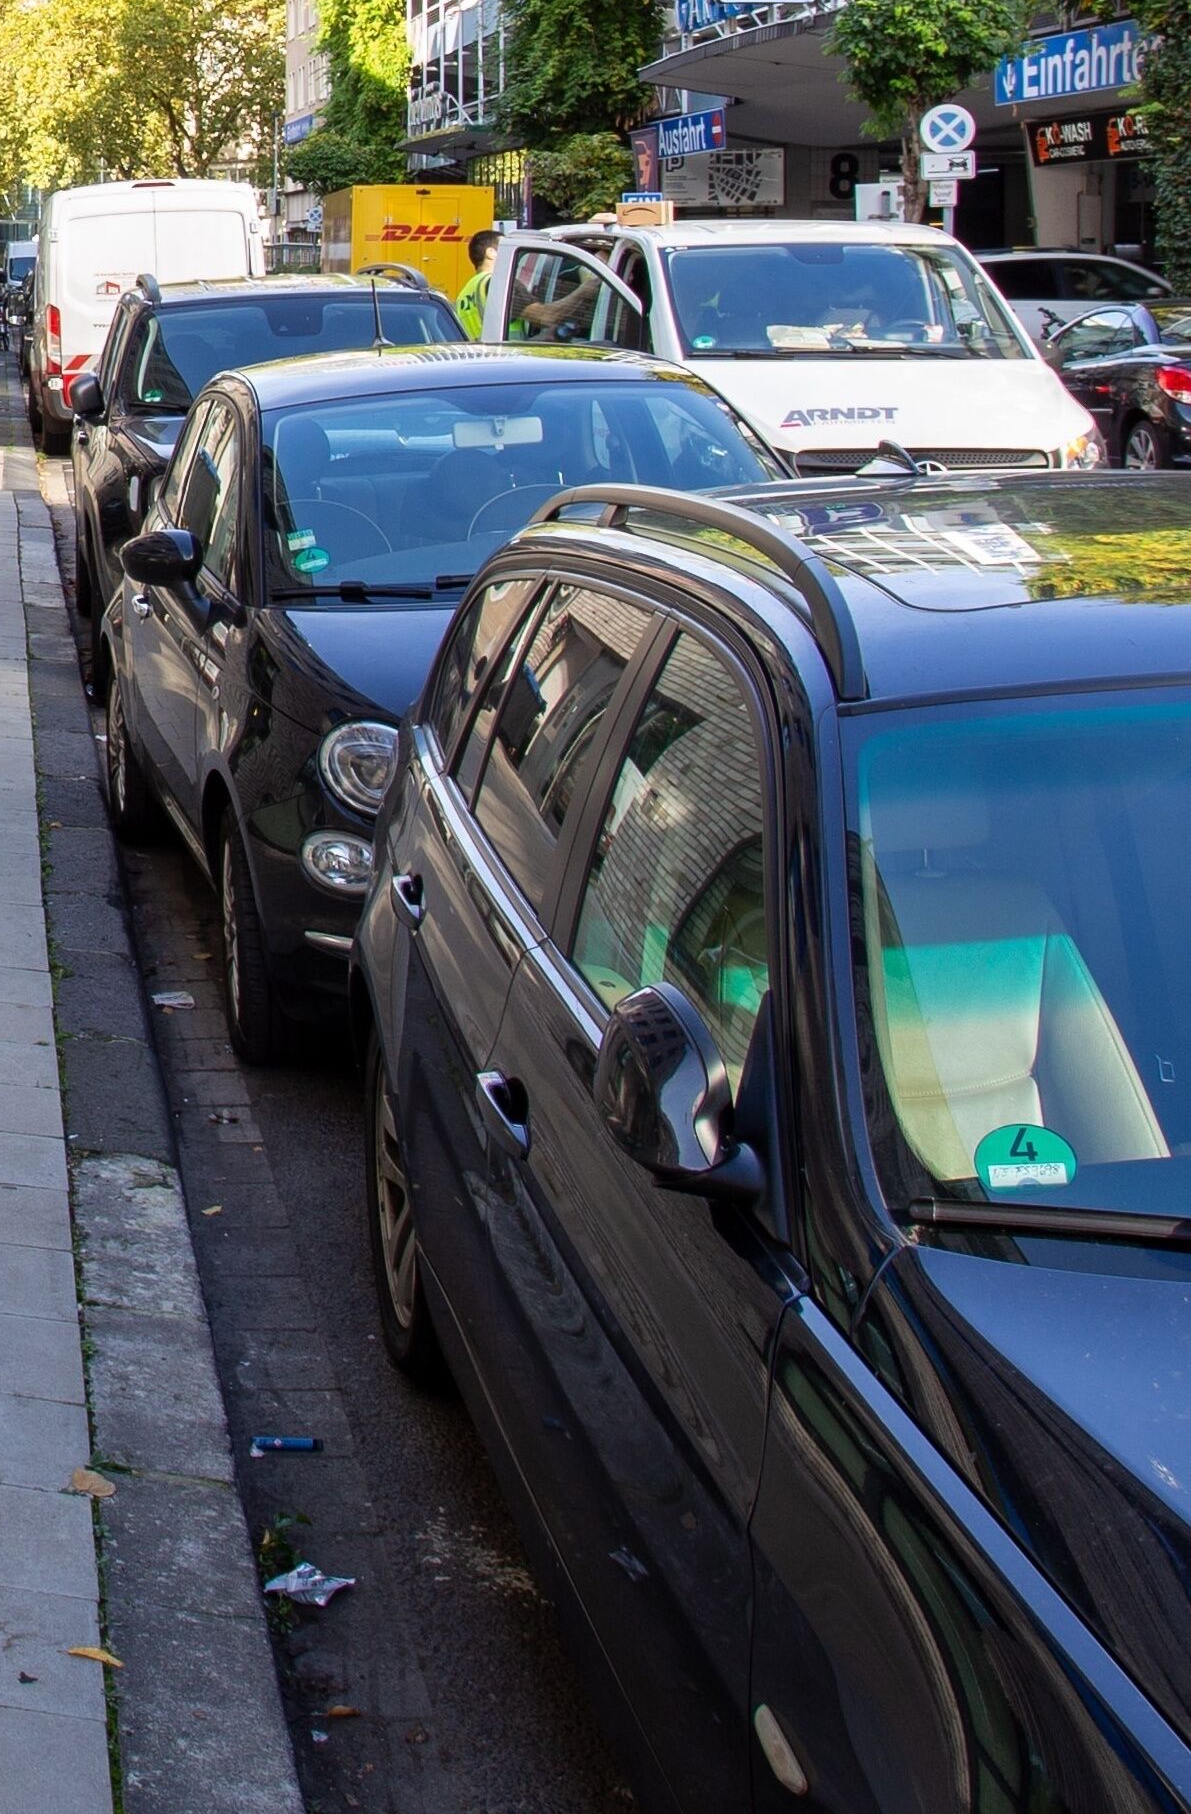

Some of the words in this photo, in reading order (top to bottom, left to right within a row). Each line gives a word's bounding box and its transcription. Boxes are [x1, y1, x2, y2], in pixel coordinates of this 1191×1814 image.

[659, 117, 706, 156] Ausfahrt
[830, 153, 859, 199] 8
[381, 225, 464, 241] DHL
[781, 407, 898, 427] ARNDT
[1009, 1127, 1038, 1161] 4
